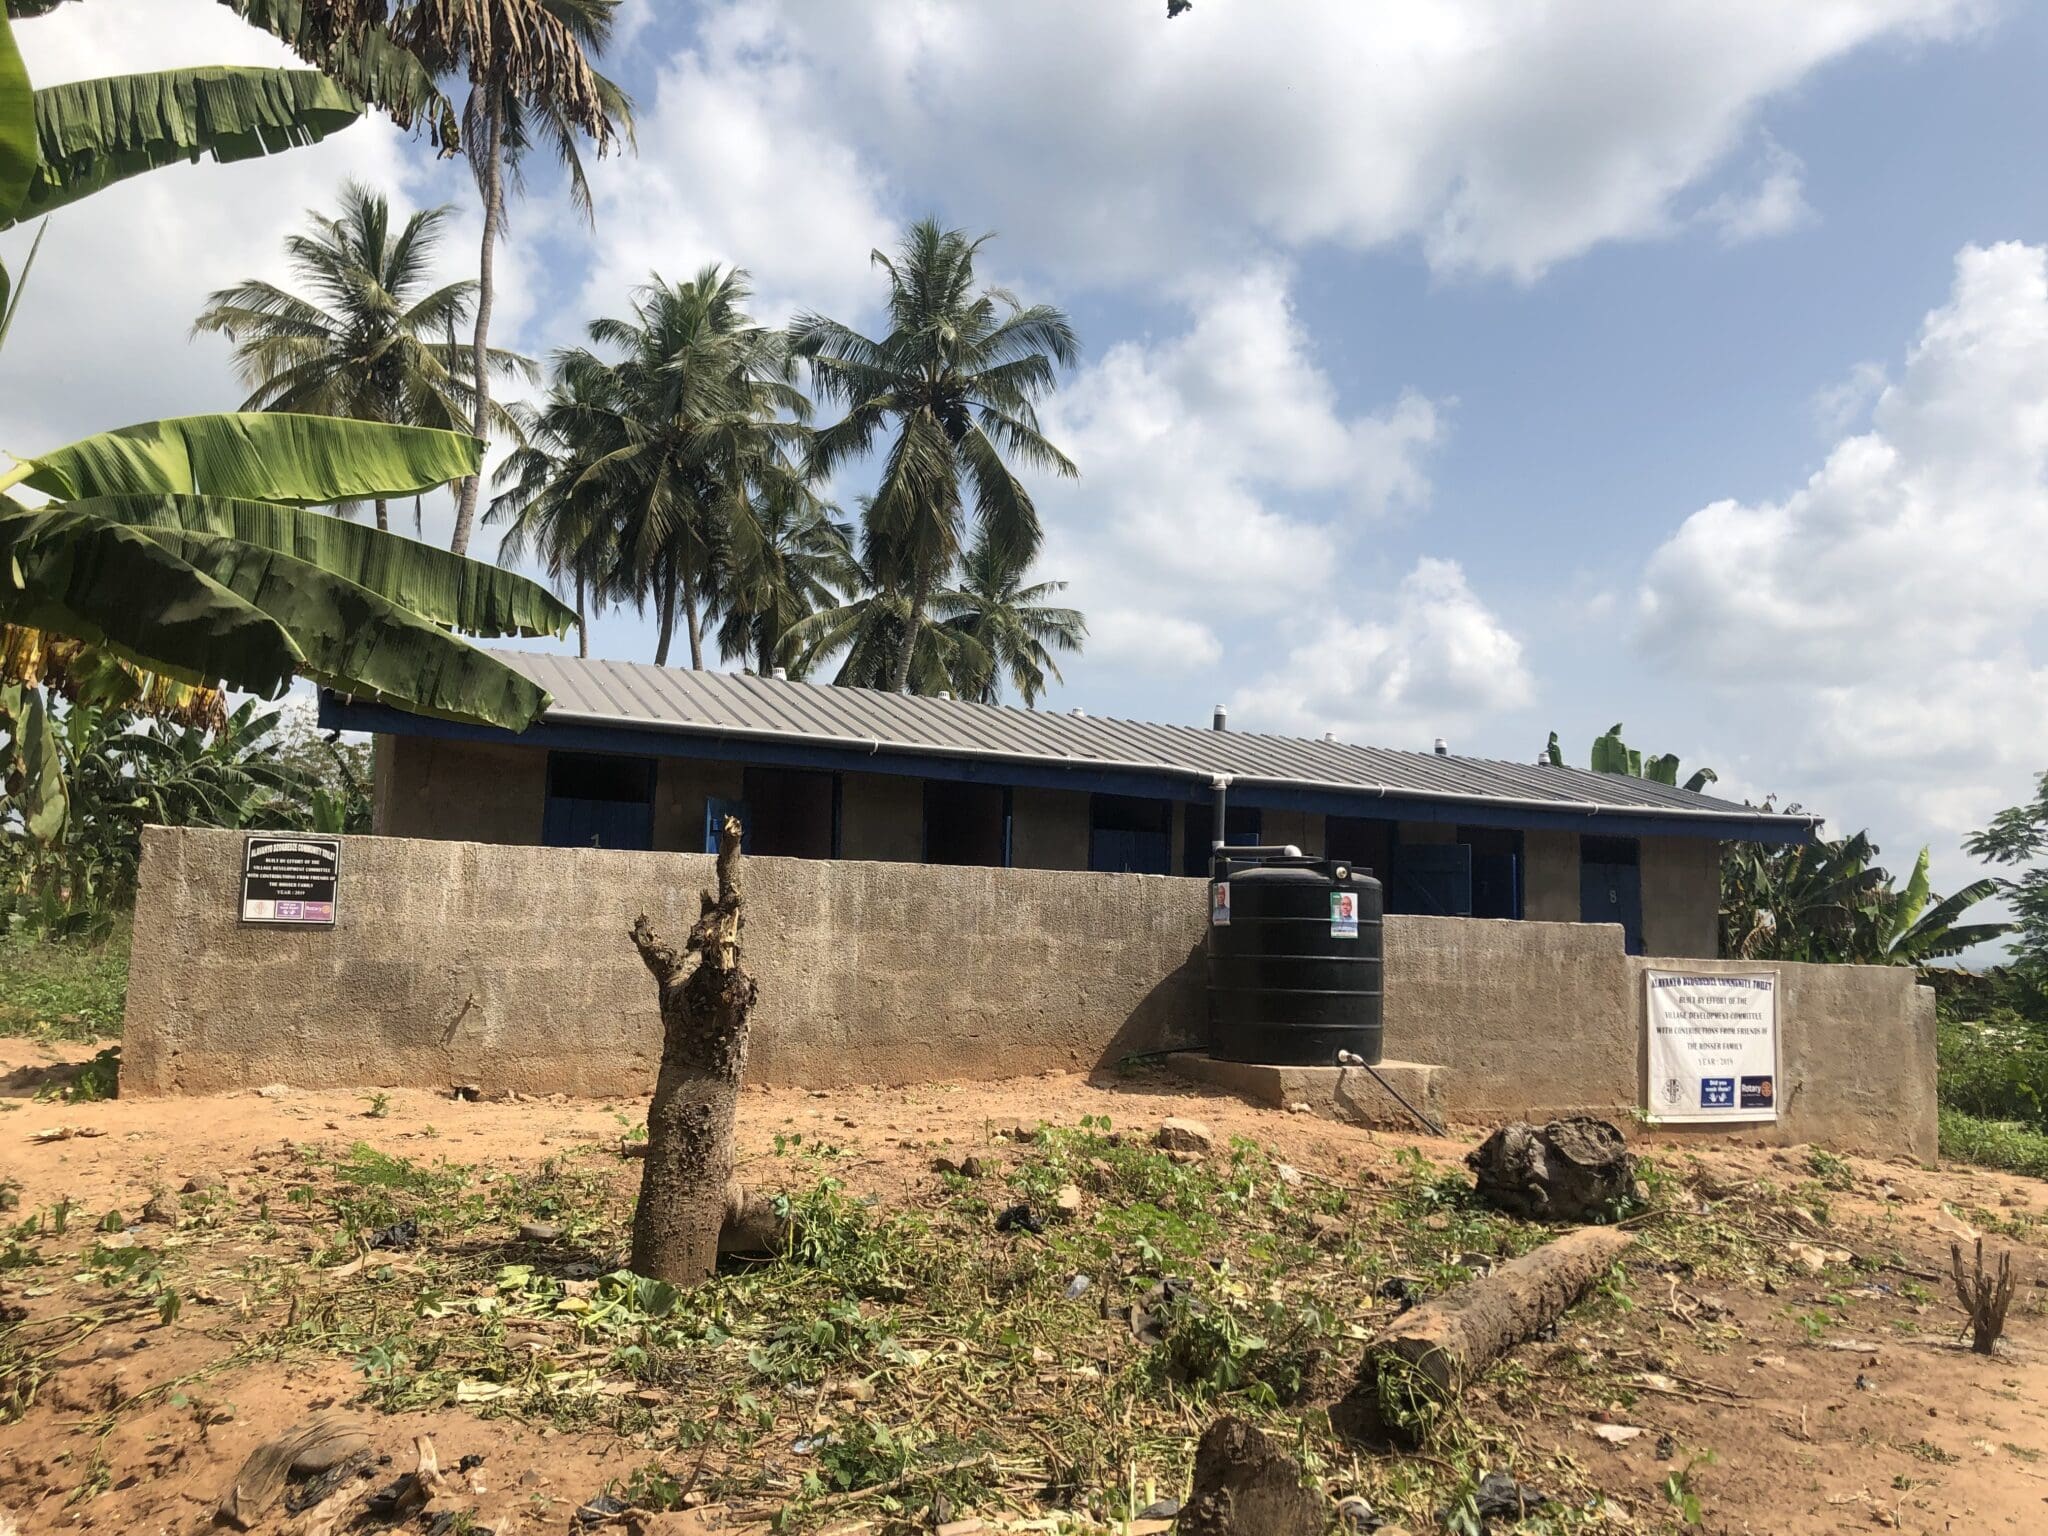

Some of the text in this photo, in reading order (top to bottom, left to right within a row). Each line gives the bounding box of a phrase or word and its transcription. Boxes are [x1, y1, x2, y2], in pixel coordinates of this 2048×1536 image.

[591, 833, 602, 848] 1
[298, 844, 322, 856] COMMUNITY
[322, 848, 336, 861] TOILET
[1609, 889, 1617, 904] 8
[1717, 977, 1751, 988] COMMUNITY
[1753, 979, 1772, 991] TOILET
[1656, 1026, 1673, 1035] WITH
[1674, 1026, 1719, 1035] CONTRIBUTIONS
[1723, 1042, 1743, 1051] FAMILY
[1698, 1057, 1716, 1066] YEAR
[1741, 1084, 1761, 1094] Rotary
